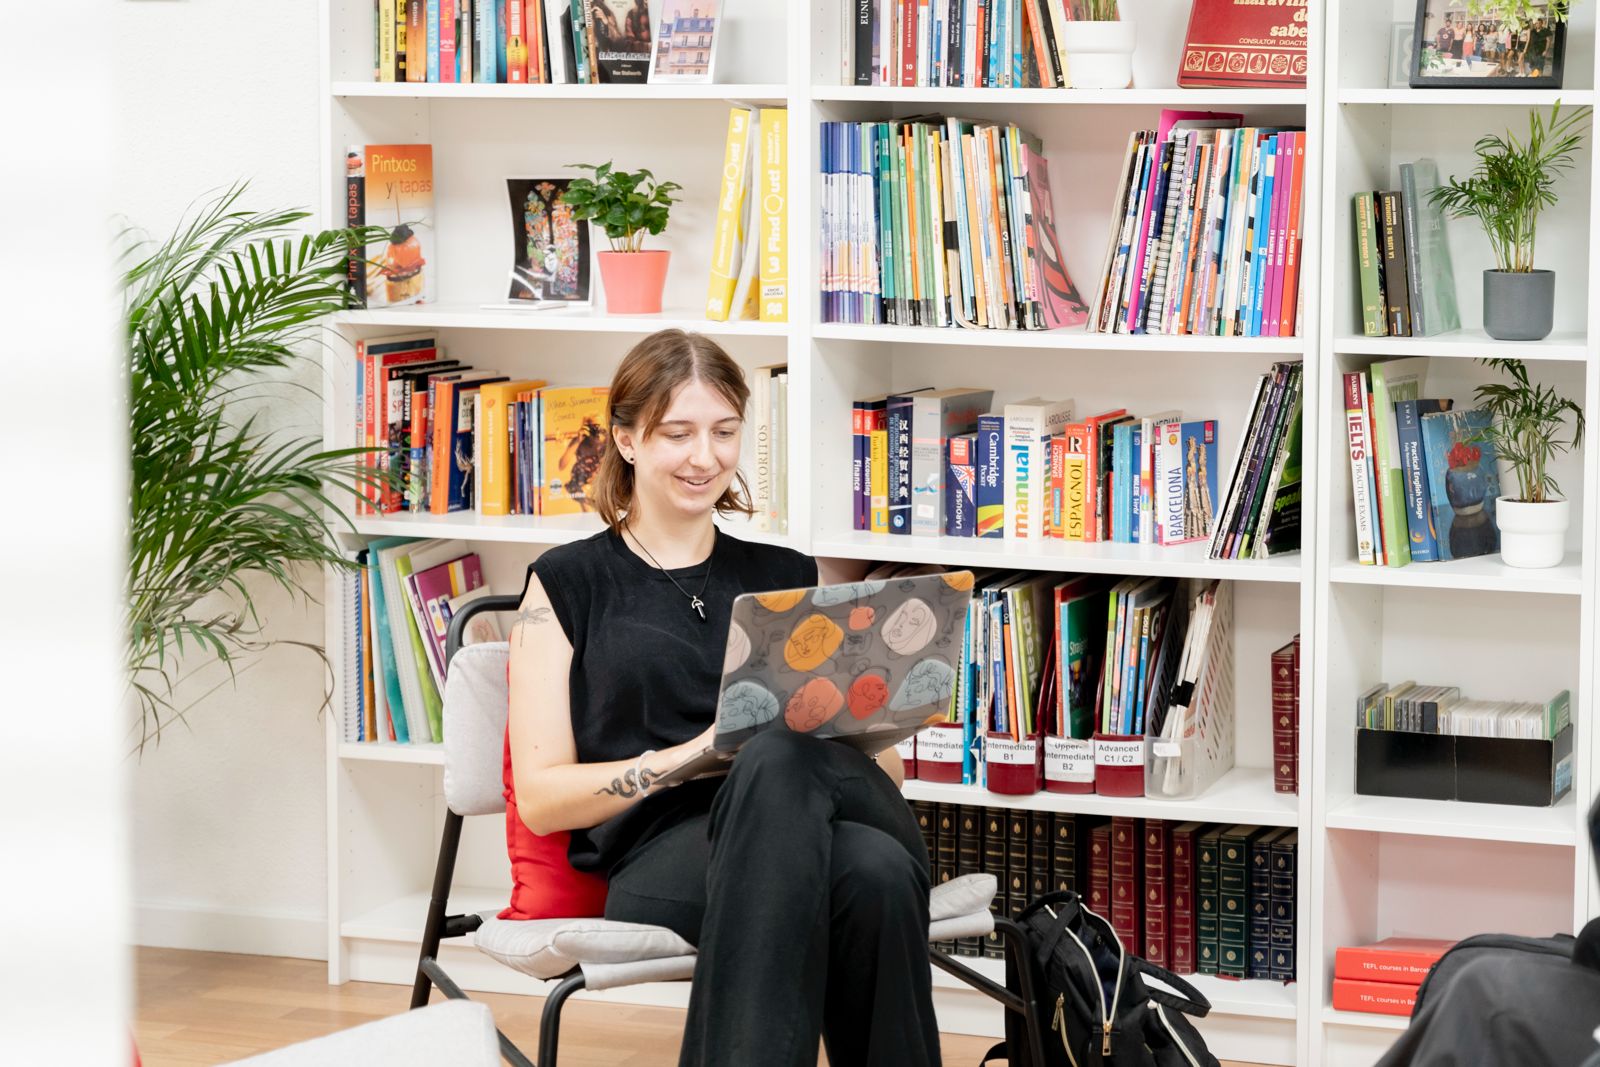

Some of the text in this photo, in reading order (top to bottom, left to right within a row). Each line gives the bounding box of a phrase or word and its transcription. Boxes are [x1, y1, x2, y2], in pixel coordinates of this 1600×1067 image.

[1270, 23, 1308, 38] sabe
[371, 154, 417, 173] Pintxos
[348, 183, 361, 219] tapas
[385, 180, 432, 199] y tapas
[722, 181, 736, 212] Find
[768, 216, 781, 252] Find
[1361, 220, 1367, 228] LA
[1363, 259, 1370, 267] LA
[1388, 251, 1395, 259] LA
[1350, 375, 1359, 405] BARRON'S
[1045, 410, 1072, 427] LAROUSSE
[1349, 416, 1365, 461] IELTS
[758, 425, 769, 500] FAVORITOS
[853, 459, 862, 491] Finance
[987, 432, 1000, 488] Cambridge
[1011, 445, 1029, 538] manual
[1410, 441, 1424, 520] Practical English Usage
[1070, 460, 1082, 538] ESPAGNOL
[1168, 467, 1183, 537] BARCELONA
[1355, 463, 1367, 532] PRACTICE EXAMS
[1022, 600, 1039, 693] speak
[987, 743, 1035, 751] ntermediate
[1054, 742, 1082, 751] Upper-
[1104, 755, 1115, 763] C1
[1122, 755, 1134, 763] C2
